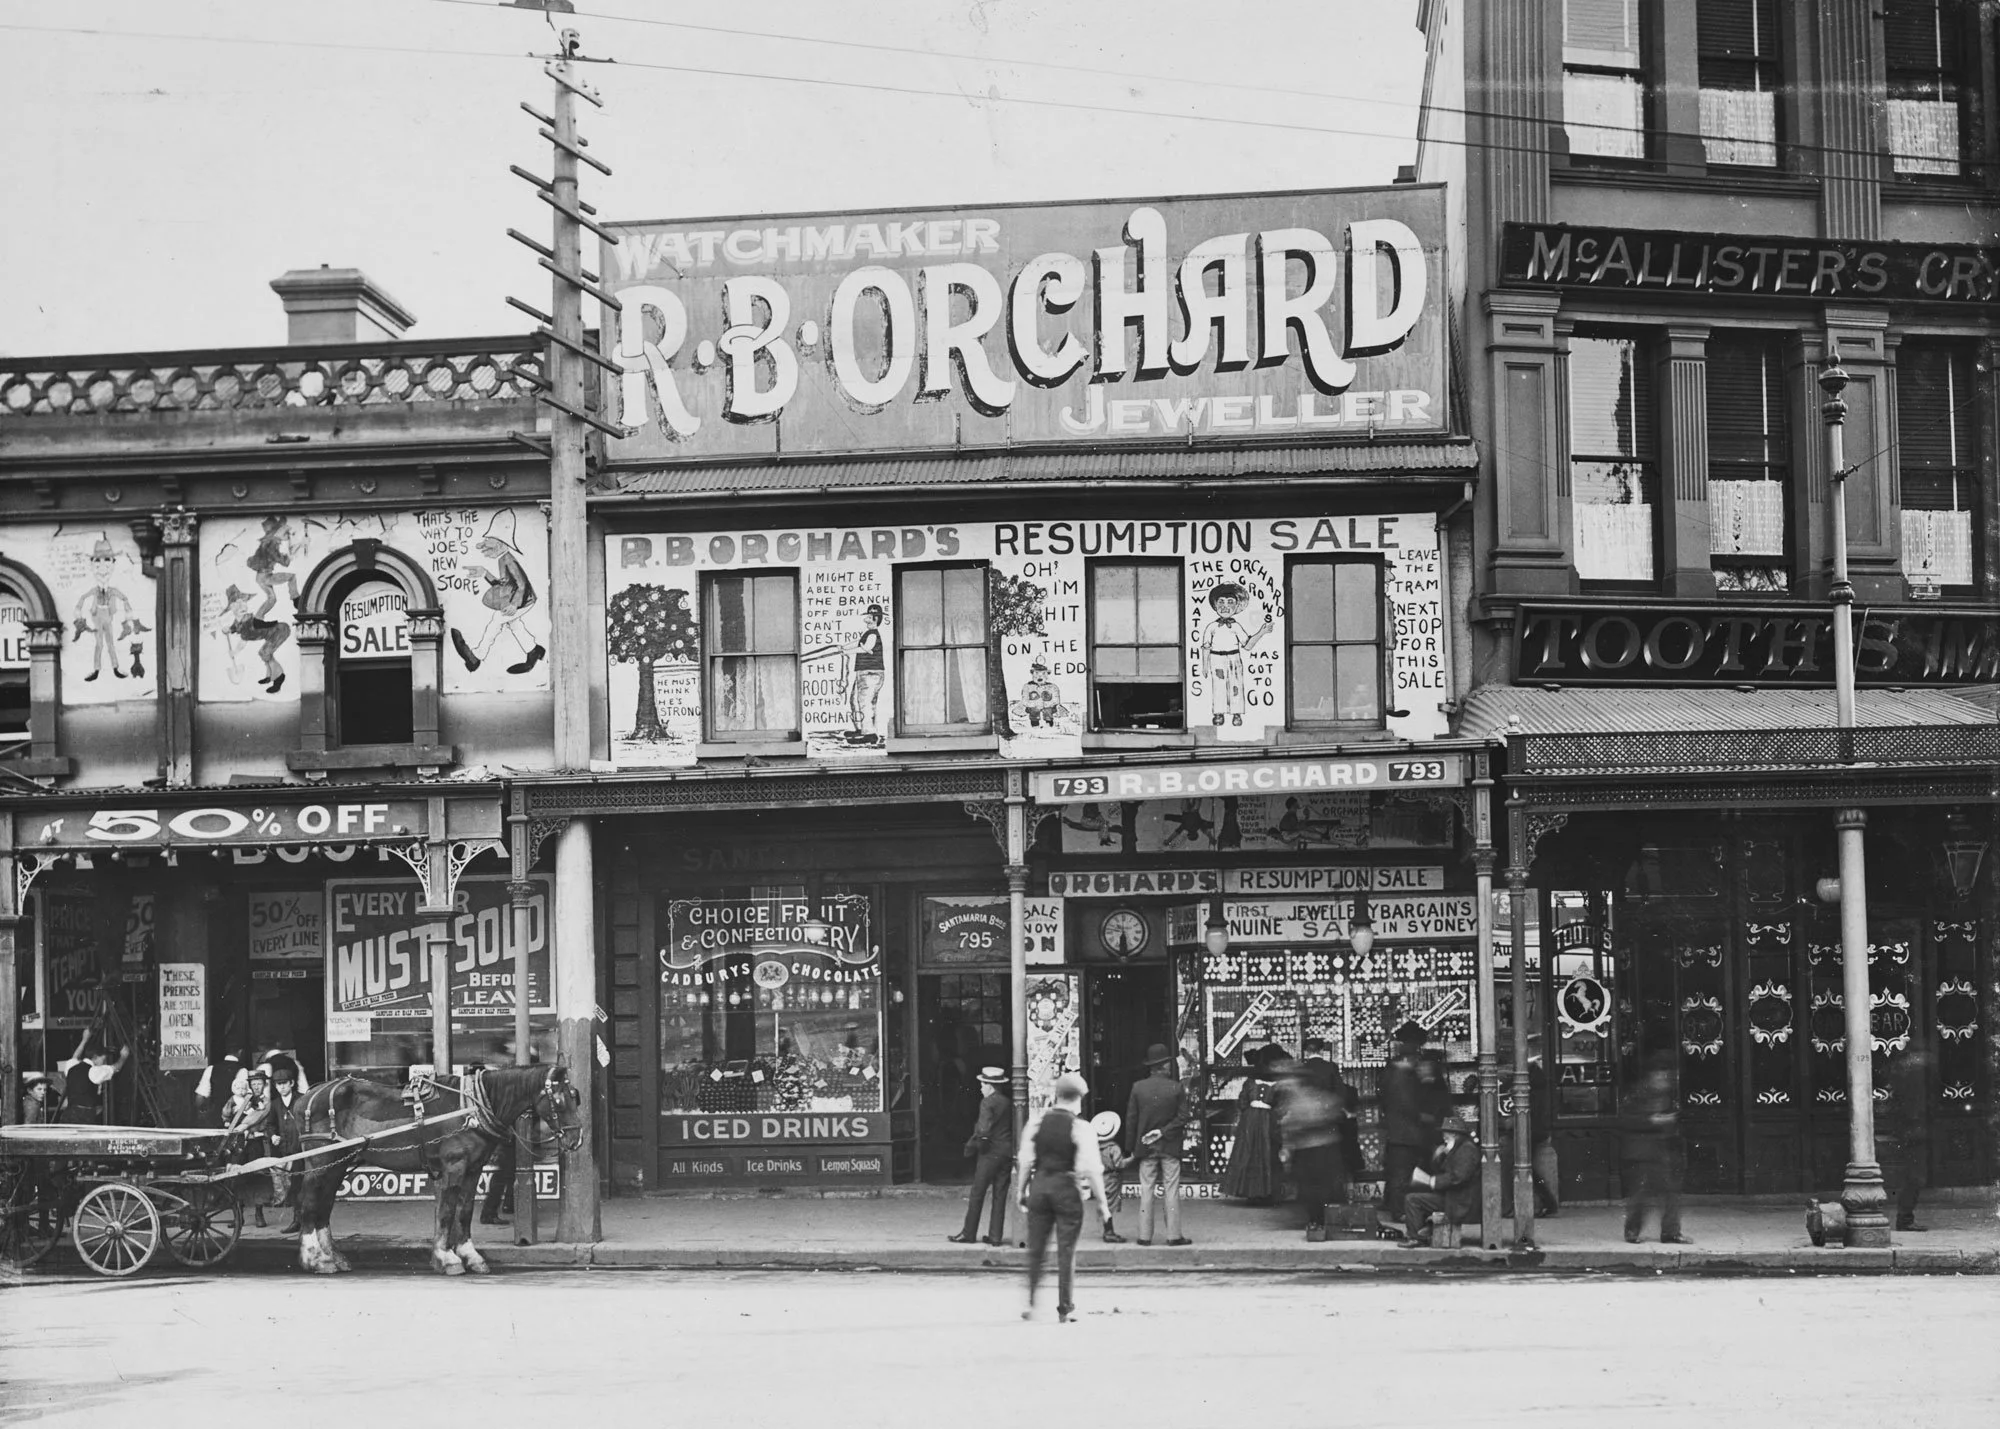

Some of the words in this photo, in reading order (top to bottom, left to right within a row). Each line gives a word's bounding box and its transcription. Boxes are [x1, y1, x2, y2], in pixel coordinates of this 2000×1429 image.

[614, 219, 1002, 281] WATCHMAKER
[1060, 384, 1433, 436] JEWELLER
[412, 509, 452, 527] THAT'S
[457, 510, 479, 525] THE
[420, 526, 449, 539] WAY
[455, 527, 473, 540] TO
[995, 520, 1252, 558] RESUMPTION
[1270, 516, 1399, 551] SALE
[1399, 549, 1438, 561] LEAVE
[433, 556, 458, 572] NEW
[1405, 563, 1434, 574] THE
[437, 575, 479, 595] STORE
[807, 572, 811, 584] I
[816, 571, 855, 584] MIGHT
[859, 571, 874, 582] BE
[1192, 574, 1224, 590] WOT
[806, 585, 836, 595] ABEL
[840, 584, 855, 593] TO
[859, 583, 882, 592] GET
[1054, 579, 1078, 595] I'M
[1190, 560, 1224, 573] THE
[1230, 558, 1285, 618] ORCHARD
[1395, 579, 1439, 595] TRAM
[343, 594, 408, 622] RESUMPTION
[807, 597, 833, 606] THE
[1397, 601, 1439, 616] NEXT
[807, 609, 829, 618] OFF
[836, 608, 854, 617] BUT
[1045, 605, 1080, 622] HIT
[804, 619, 842, 632] CAN'T
[1398, 618, 1442, 636] STOP
[343, 625, 409, 653] SALE
[804, 631, 863, 645] DESTROY
[1400, 637, 1436, 652] FOR
[1007, 642, 1031, 655] ON
[1042, 639, 1078, 653] THE
[1250, 651, 1280, 661] HAS
[1396, 654, 1439, 669] THIS
[807, 662, 835, 675] THE
[1248, 663, 1274, 674] GOT
[671, 678, 697, 686] MUST
[1253, 677, 1272, 687] TO
[1397, 670, 1445, 689] SALE
[803, 698, 815, 707] OF
[818, 697, 841, 706] THIS
[1247, 689, 1275, 706] GO
[804, 710, 865, 724] ORCHARD
[1057, 778, 1105, 797] 793
[1392, 760, 1442, 781] 793
[40, 818, 65, 842] AT
[1049, 869, 1218, 896] ORCHARD'S
[1239, 869, 1369, 889] RESUMPTION
[1377, 868, 1428, 888] SALE
[252, 896, 300, 928] 50%
[335, 891, 407, 932] EVERY
[689, 906, 770, 925] CHOICE
[1226, 904, 1270, 917] FIRST
[1287, 903, 1379, 921] JEWELLEY
[296, 914, 319, 928] OFF
[938, 913, 988, 933] SANTAMARIA
[1230, 918, 1283, 936] NUINE
[1383, 921, 1398, 933] IN
[1407, 918, 1477, 933] SYDNEY
[455, 894, 545, 973] SOLD
[959, 931, 993, 949] 795
[253, 934, 288, 953] EVERY
[291, 931, 320, 947] LINE
[51, 946, 97, 994] TEMPT
[338, 923, 433, 1004] MUST
[163, 969, 195, 982] THESE
[469, 972, 537, 987] BEFOE
[661, 963, 751, 986] CADBURYS
[791, 962, 882, 983] CHOCOLATE
[163, 985, 200, 997] PREMISES
[66, 988, 97, 1012] YOU
[179, 1000, 201, 1011] STILL
[168, 1013, 193, 1027] OPEN
[1870, 1012, 1904, 1033] BAR
[174, 1030, 191, 1040] FOR
[164, 1044, 202, 1057] BUSINESS
[682, 1119, 751, 1140] ICED
[761, 1117, 869, 1139] DRINKS
[671, 1162, 686, 1174] All
[691, 1160, 724, 1175] Kinds
[746, 1159, 764, 1172] Ice
[766, 1159, 802, 1173] Drinks
[821, 1158, 850, 1173] Lemon
[850, 1158, 881, 1173] Squash
[1200, 1185, 1221, 1199] BE
